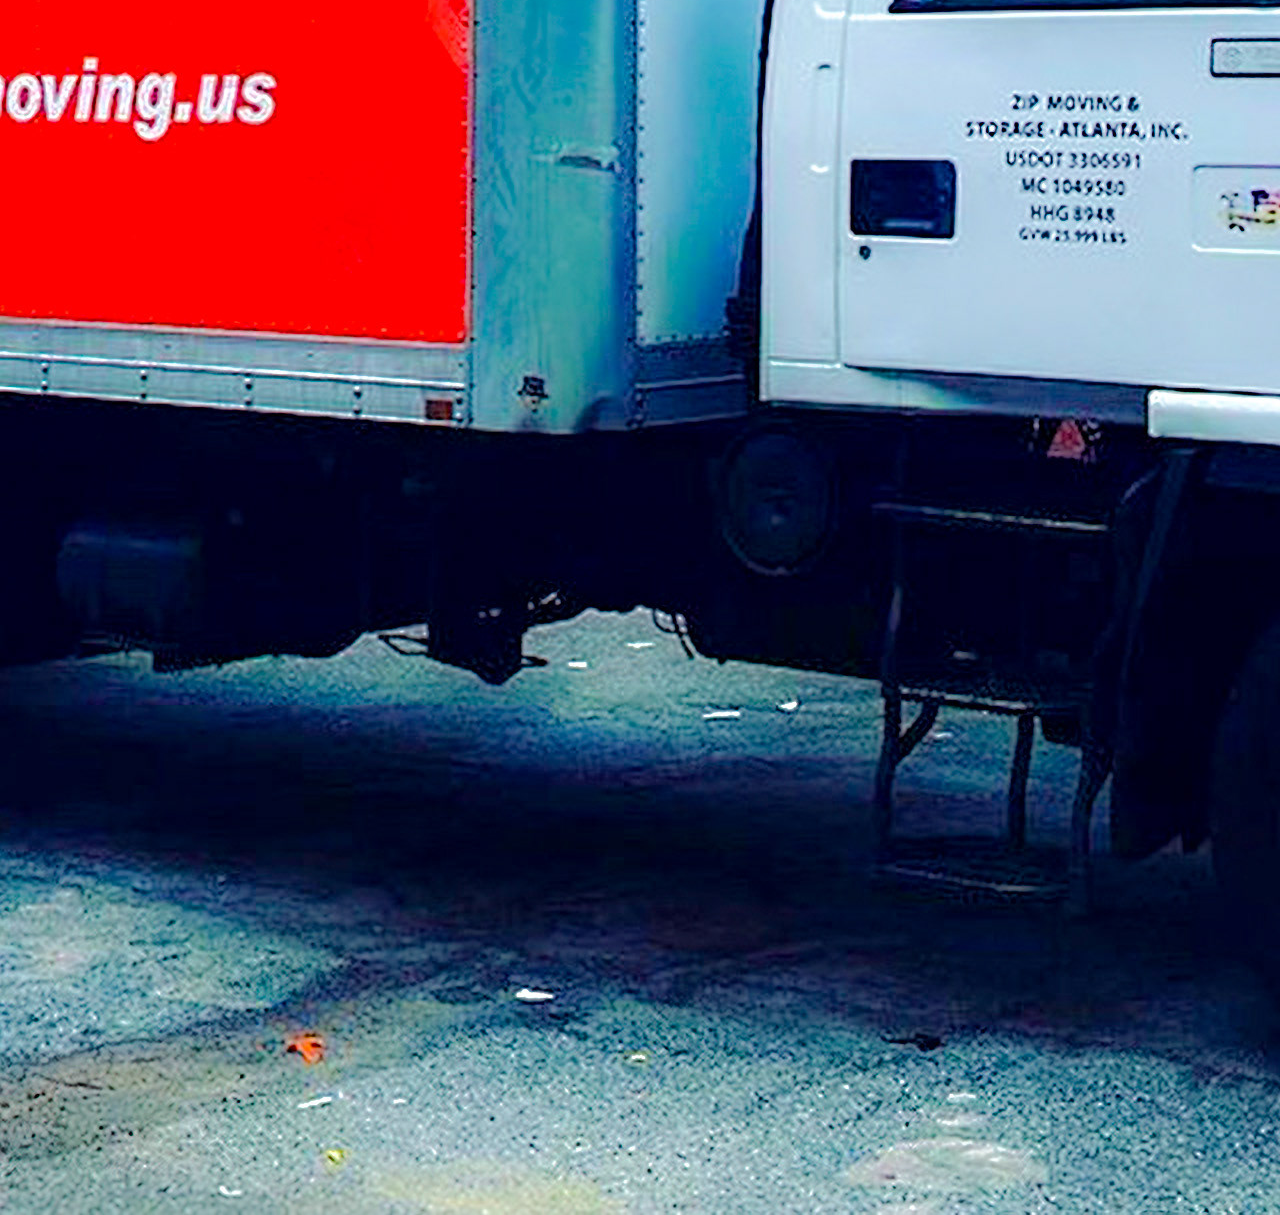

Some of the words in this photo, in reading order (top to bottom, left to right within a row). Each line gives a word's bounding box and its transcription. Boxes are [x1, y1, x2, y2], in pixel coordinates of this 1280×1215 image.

[1012, 95, 1039, 110] ZIP
[1047, 96, 1122, 111] MOVING
[966, 121, 1045, 137] STORAGE
[1151, 122, 1191, 139] INC.
[1006, 151, 1063, 167] USDOT
[1022, 177, 1047, 194] MC
[1031, 205, 1069, 221] HHG
